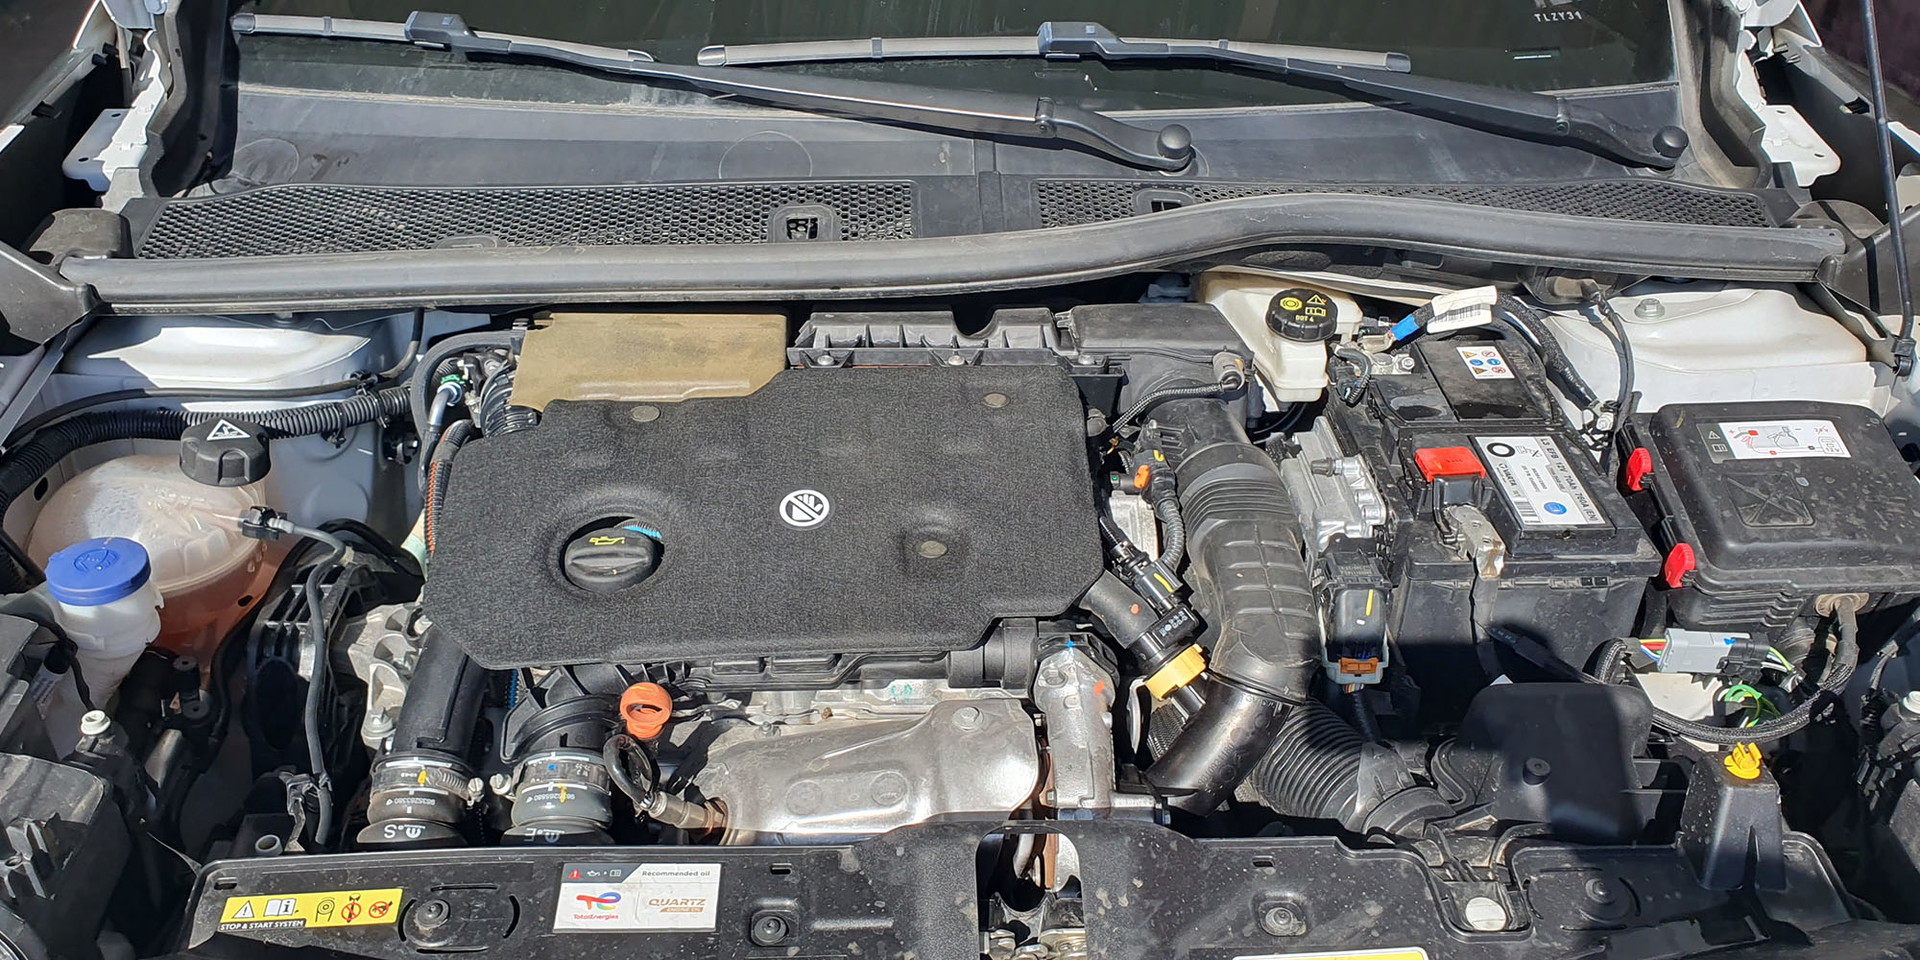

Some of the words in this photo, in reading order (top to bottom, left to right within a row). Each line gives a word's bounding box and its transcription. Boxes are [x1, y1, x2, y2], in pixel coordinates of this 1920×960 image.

[648, 898, 706, 906] QUARTZ
[220, 923, 242, 931] STOP
[274, 920, 304, 928] SYSTEM
